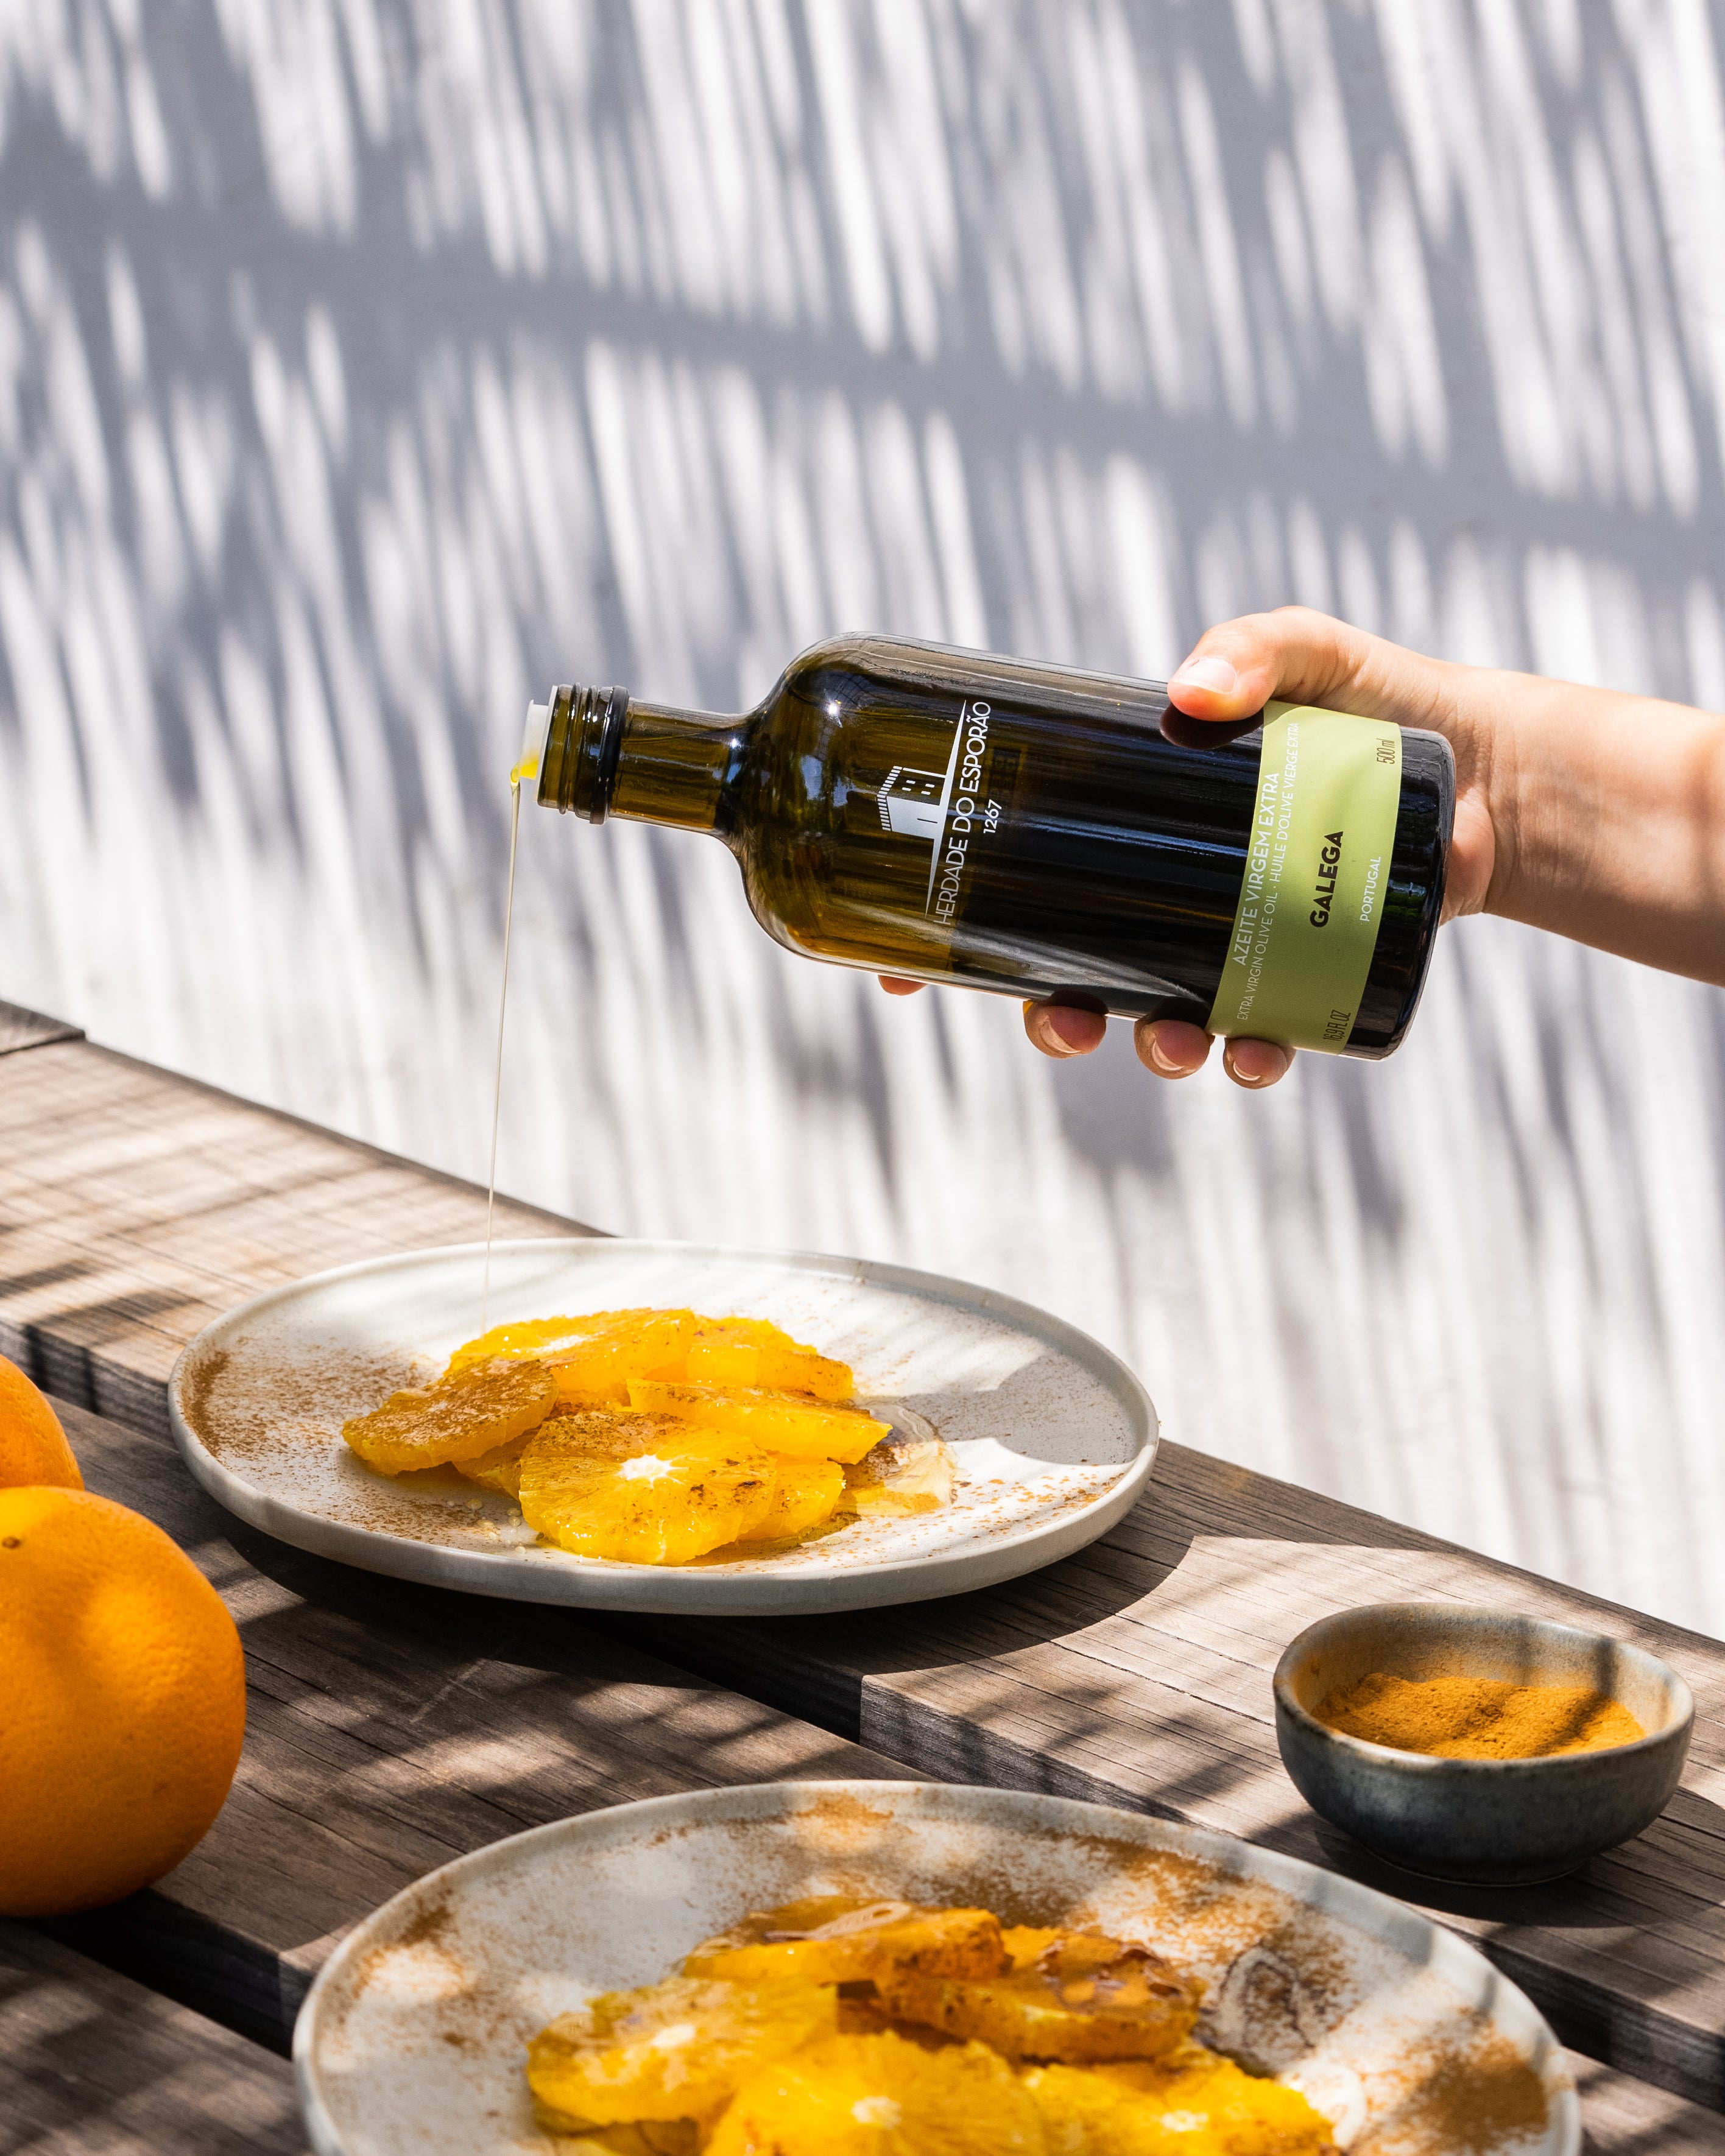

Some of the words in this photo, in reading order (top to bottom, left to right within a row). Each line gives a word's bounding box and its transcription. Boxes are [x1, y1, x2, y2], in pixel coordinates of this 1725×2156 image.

[959, 702, 990, 792] ESPORÃO
[1287, 723, 1299, 747] EXTRA
[1283, 749, 1298, 788] VIERGE
[1377, 748, 1395, 764] 500
[952, 797, 975, 833] DO
[983, 799, 1002, 834] 1267
[1258, 773, 1279, 826] EXTRA
[934, 837, 968, 925] HERDADE
[1245, 831, 1272, 901] VIRGEM
[1269, 844, 1286, 882] HUILE
[1309, 831, 1343, 928] GALEGA
[1264, 893, 1278, 914] OIL
[1360, 856, 1381, 921] PORTUGAL
[1232, 907, 1258, 966] AZEITE
[1255, 917, 1273, 954] OLIVE
[1245, 957, 1263, 992] VIRGIN
[1237, 996, 1255, 1020] EXTRA
[1330, 1010, 1351, 1021] OZ
